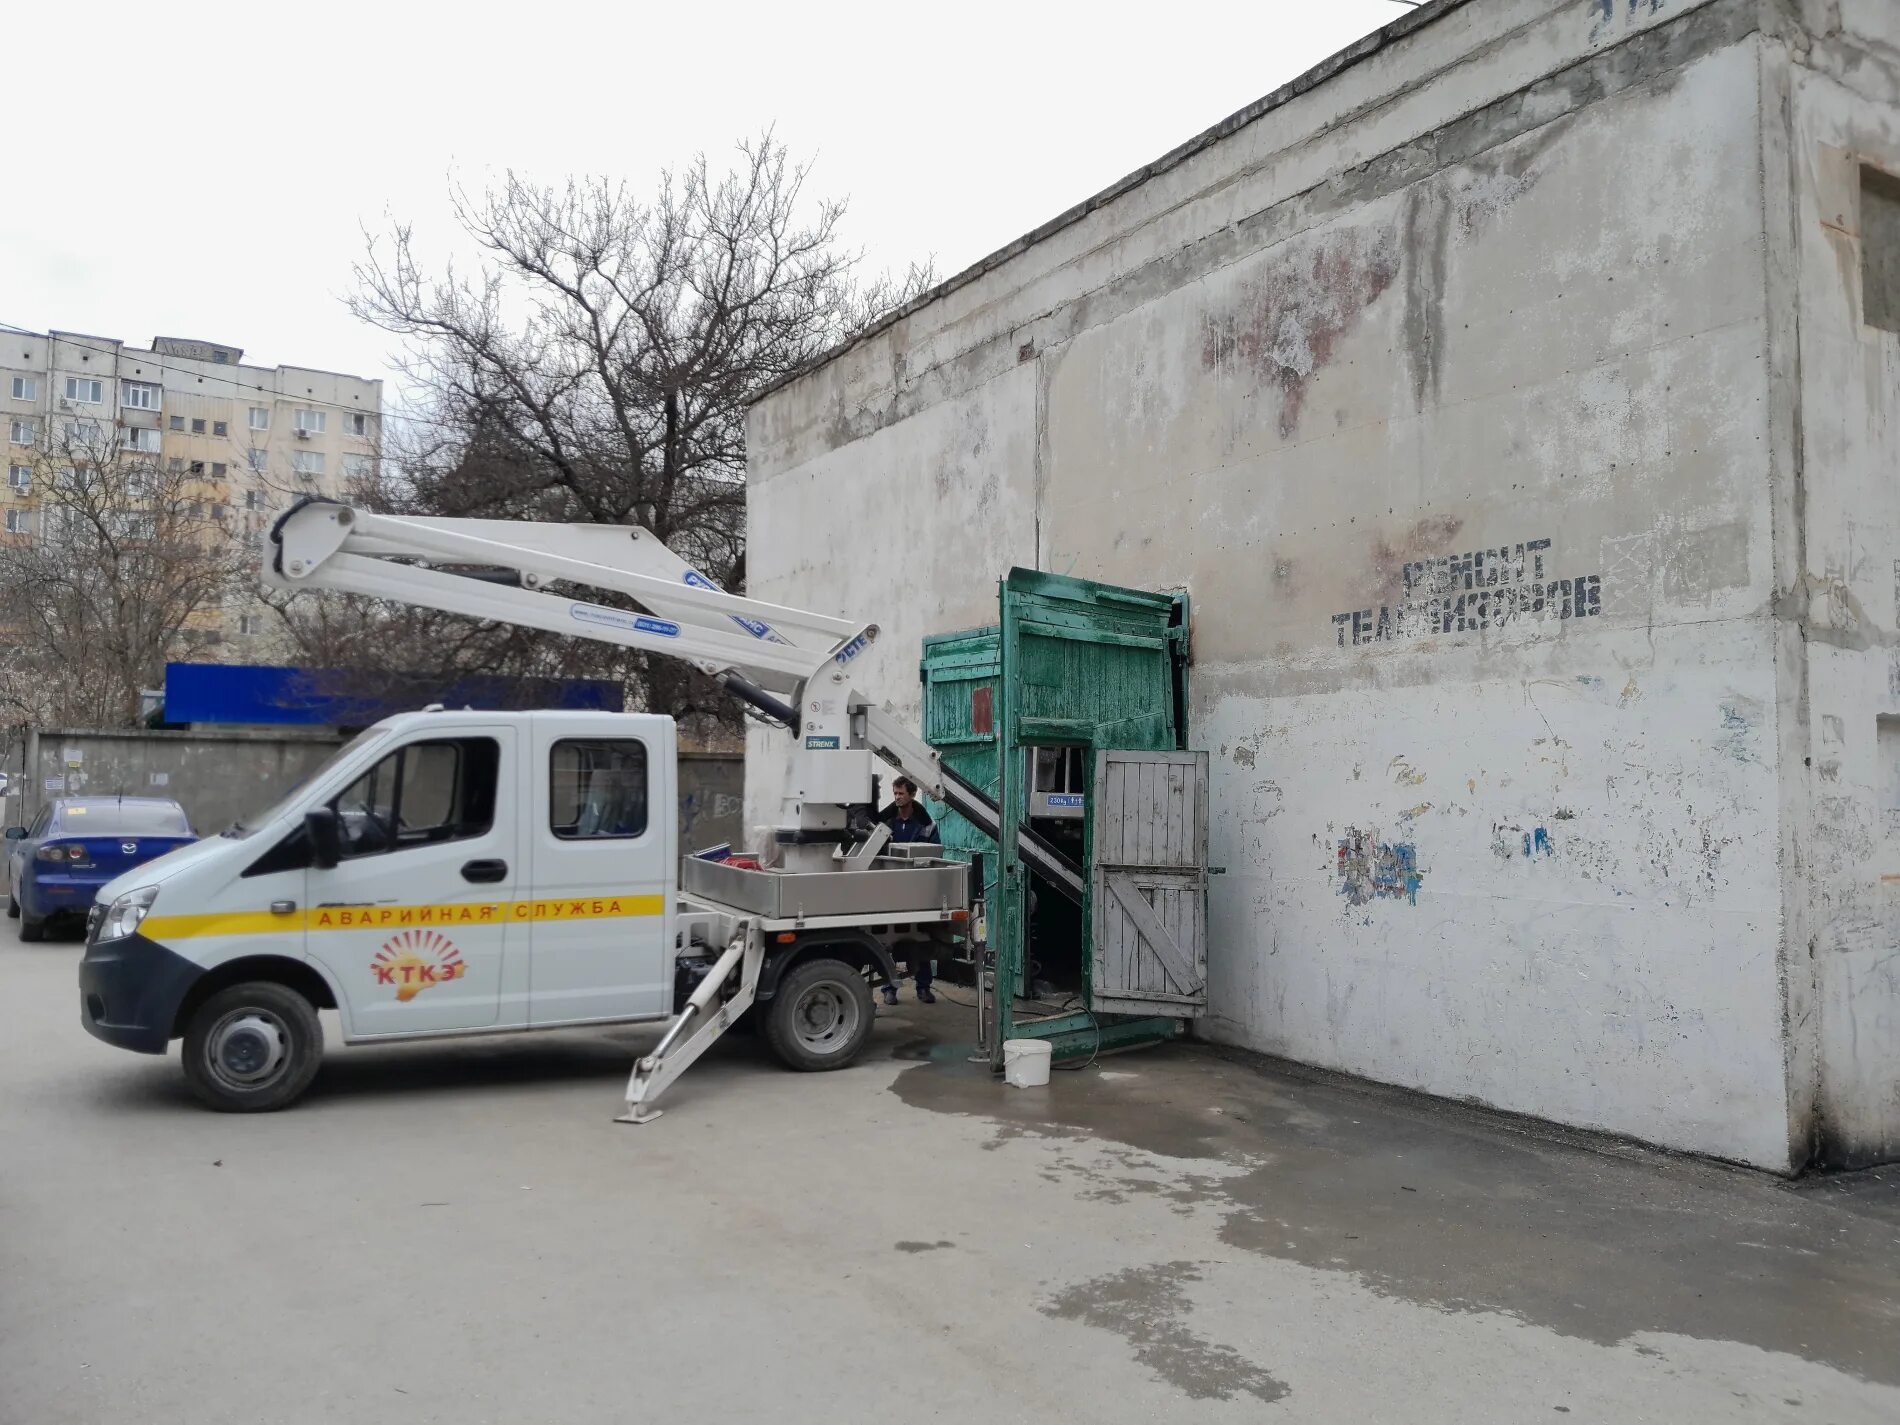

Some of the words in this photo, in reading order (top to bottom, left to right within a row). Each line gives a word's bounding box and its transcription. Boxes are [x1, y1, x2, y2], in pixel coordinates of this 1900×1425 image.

[1402, 537, 1551, 598] РЕМОНТ
[318, 908, 493, 926] АВАРИЙНАЯ
[515, 900, 623, 918] СЛУЖБА
[378, 964, 454, 984] КТКЭ
